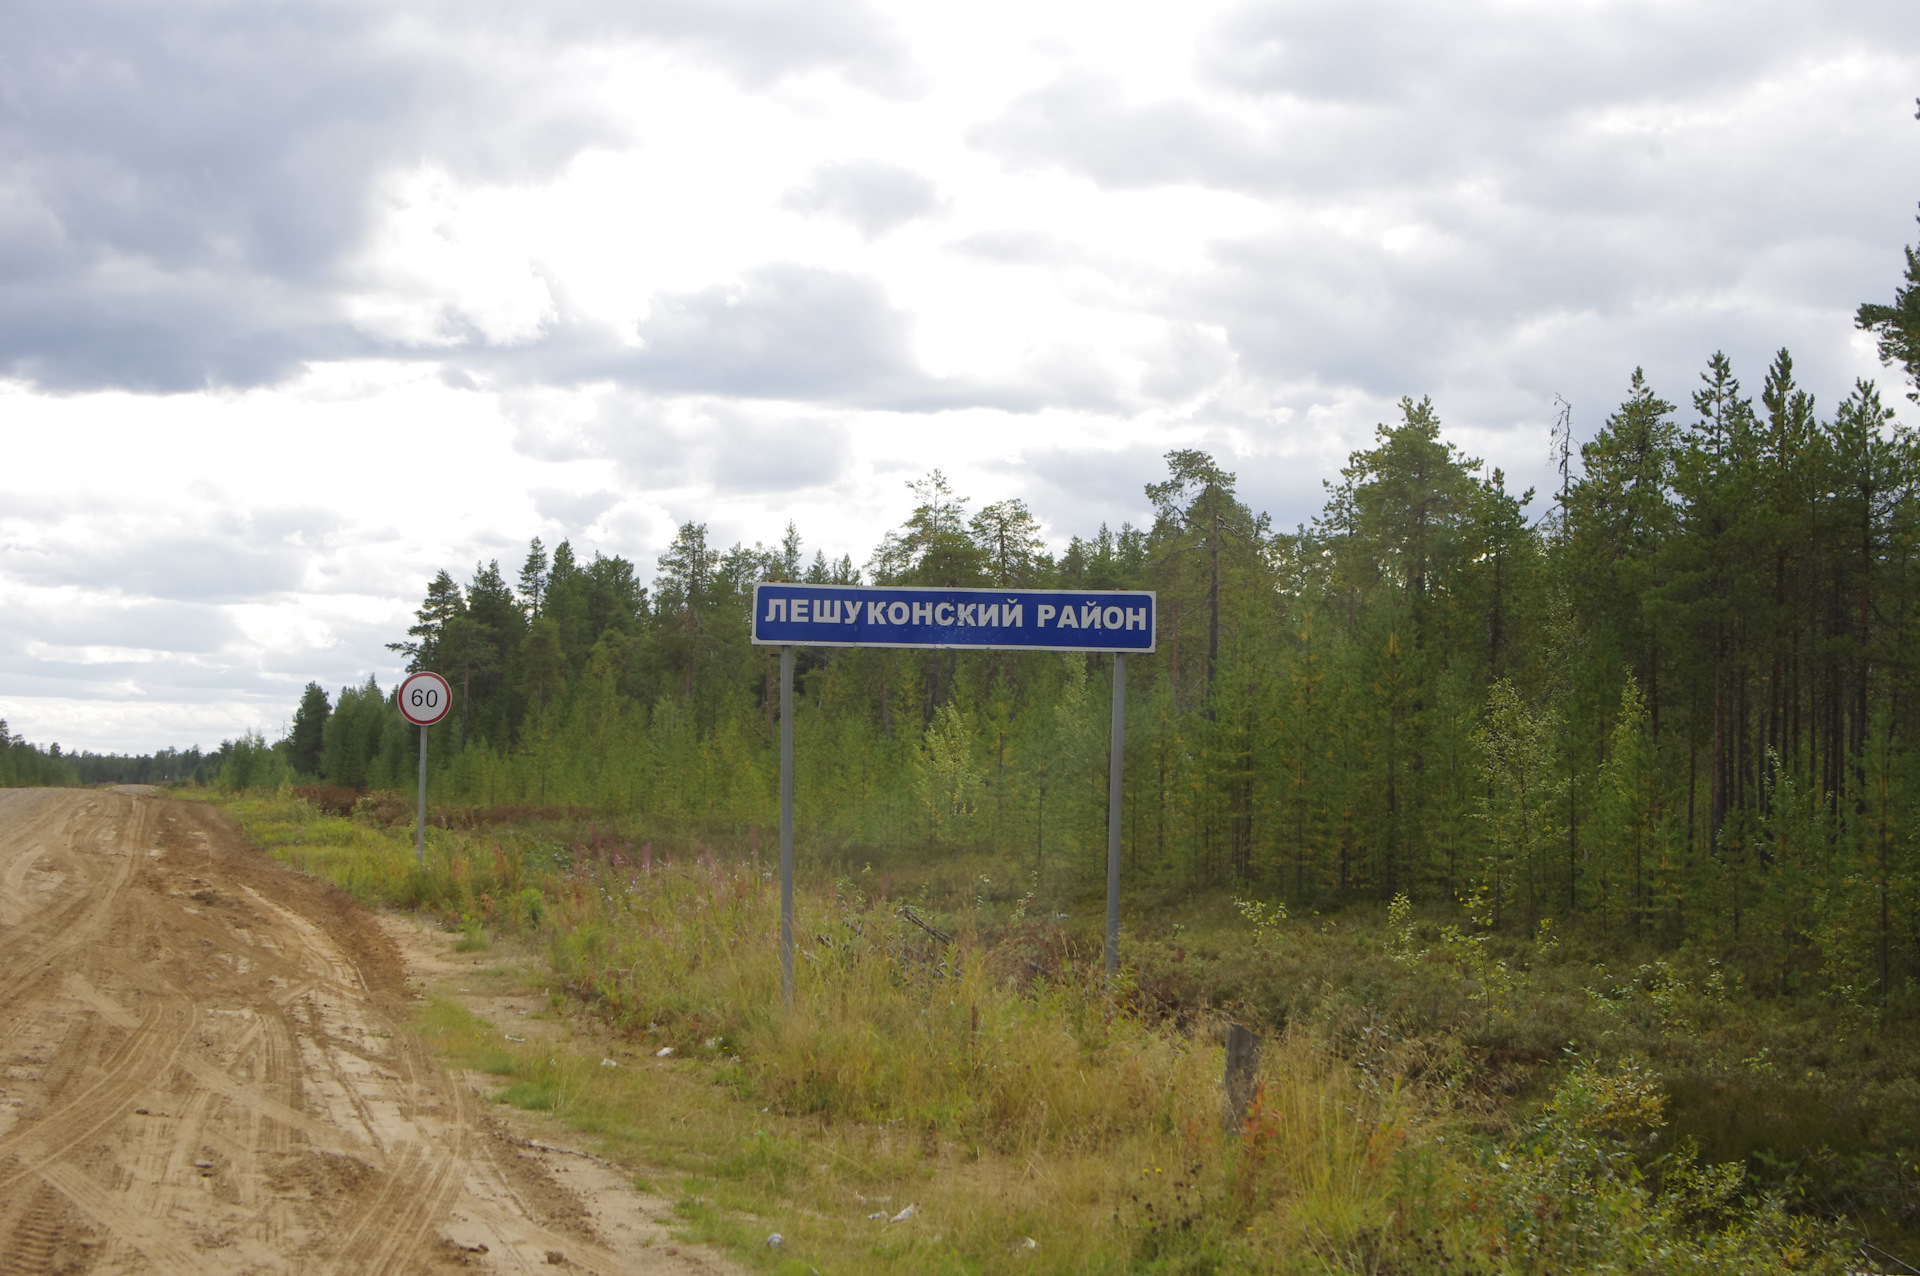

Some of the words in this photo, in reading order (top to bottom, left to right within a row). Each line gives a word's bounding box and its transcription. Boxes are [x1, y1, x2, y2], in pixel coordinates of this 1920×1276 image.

[765, 598, 1023, 628] ЛЕШУКОНСКИЙ
[1037, 601, 1146, 631] РАЙОН
[411, 688, 438, 708] 60
